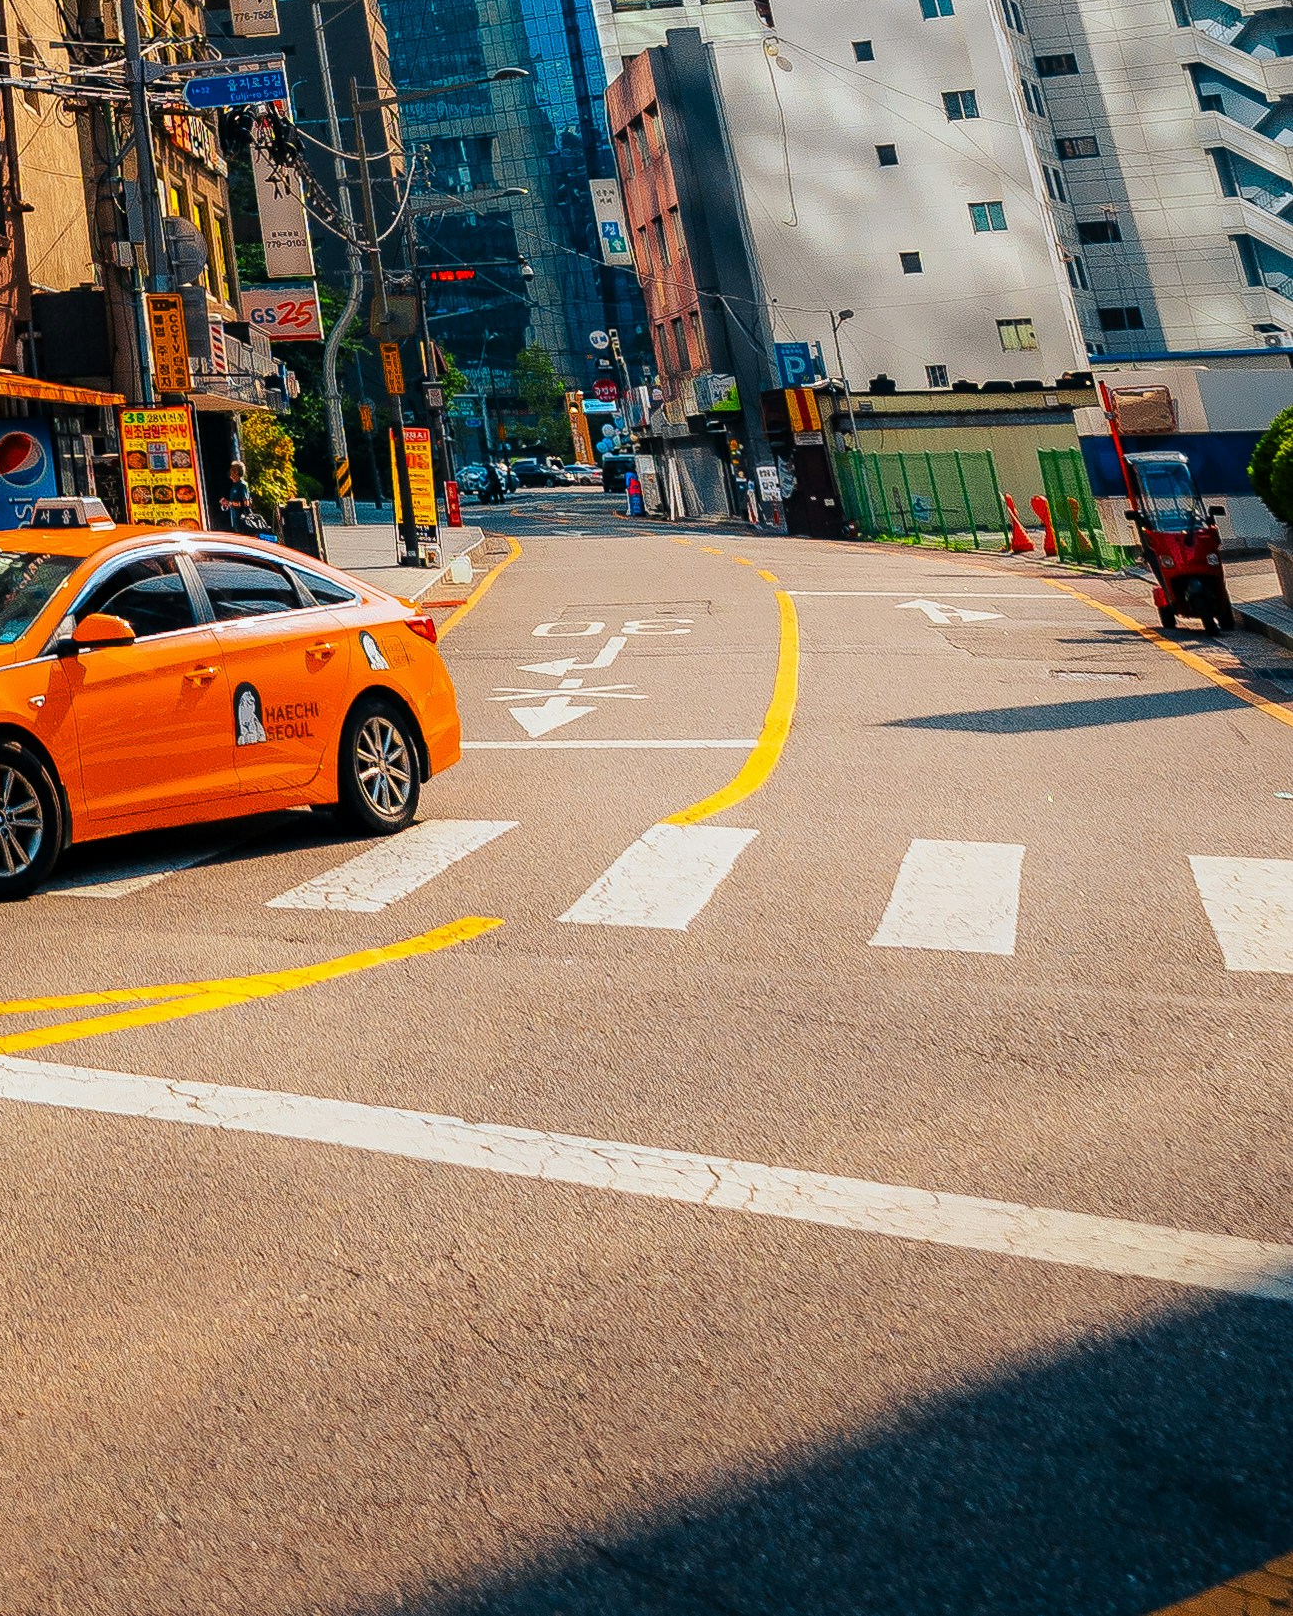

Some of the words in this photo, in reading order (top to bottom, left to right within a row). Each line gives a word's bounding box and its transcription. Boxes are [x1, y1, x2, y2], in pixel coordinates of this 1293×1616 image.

[265, 238, 307, 249] 779-0103
[250, 299, 317, 328] GS25
[169, 314, 181, 354] CCTV
[784, 356, 806, 384] P
[40, 509, 72, 524] 서울
[264, 702, 320, 721] HAECHI
[265, 723, 313, 742] SEOUL
